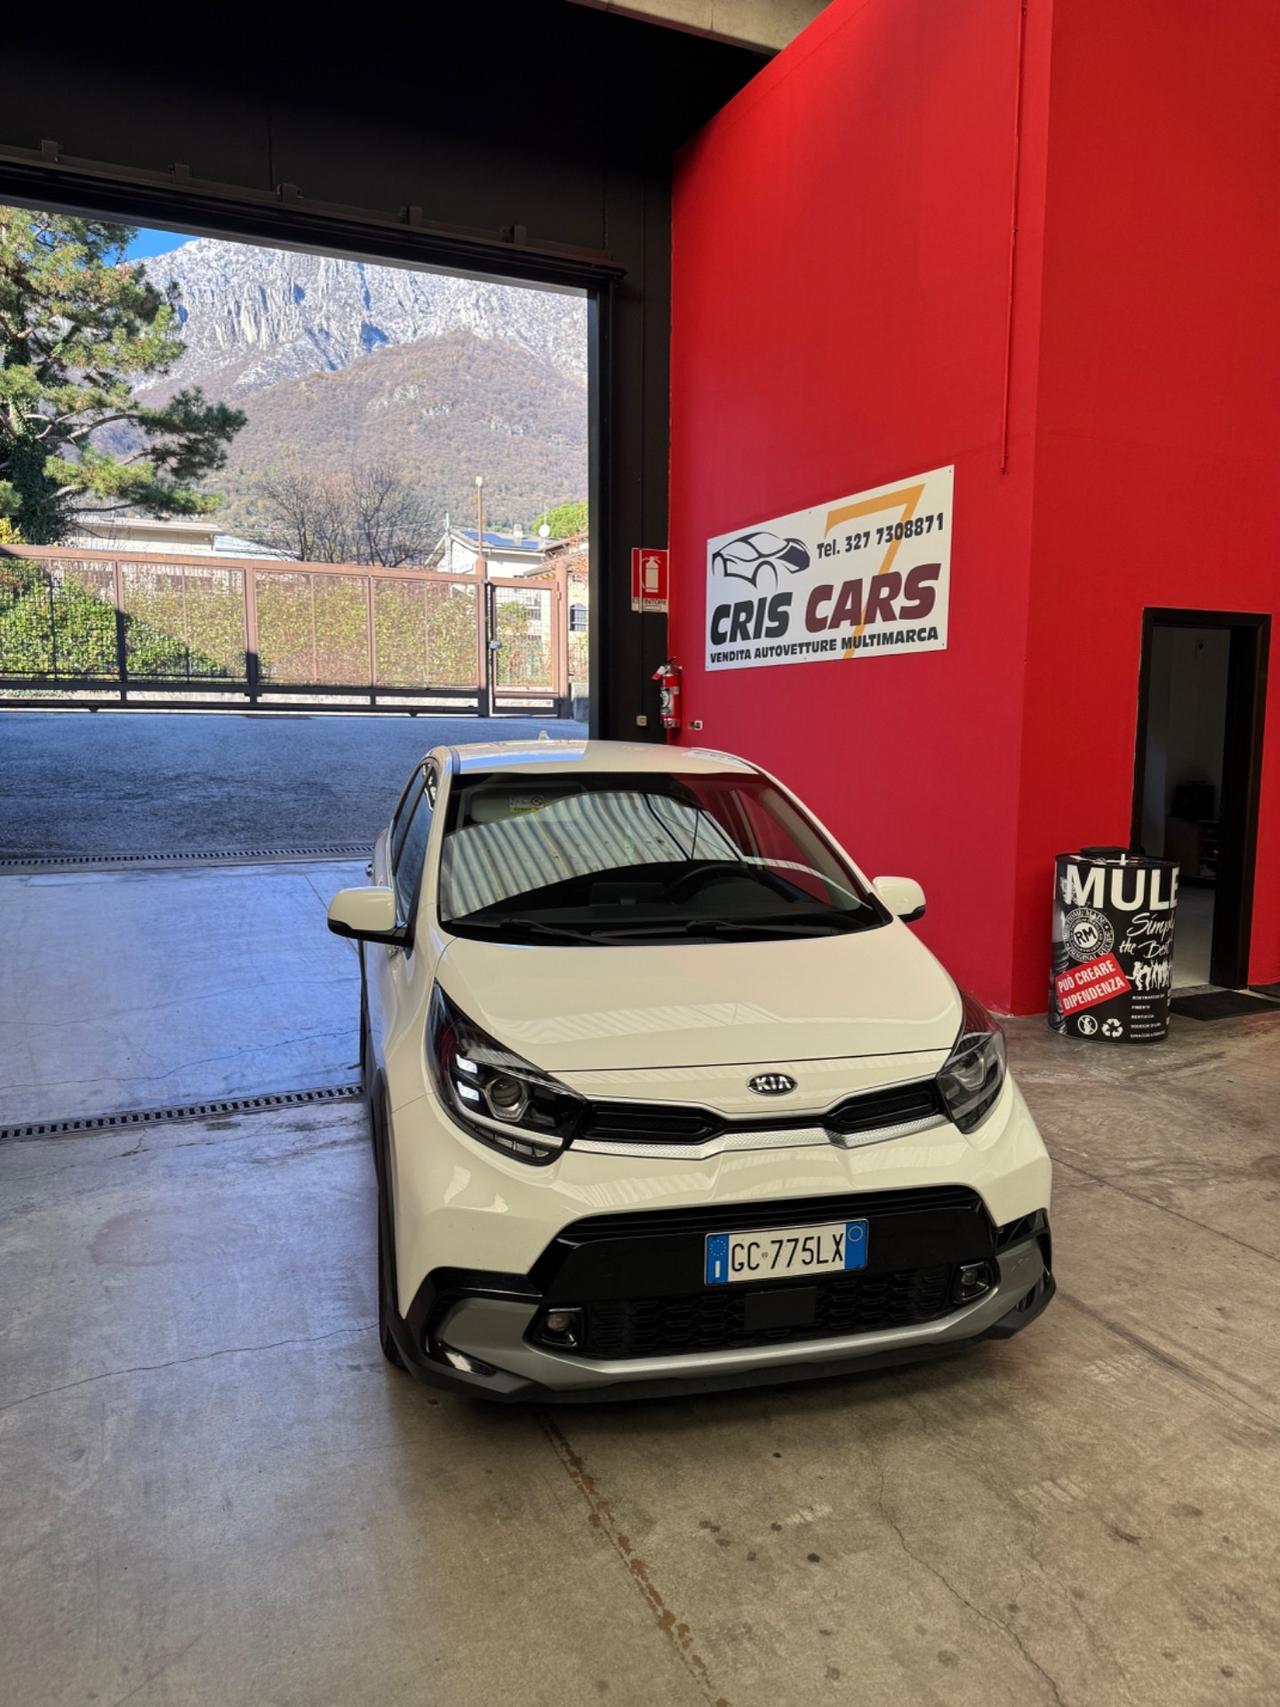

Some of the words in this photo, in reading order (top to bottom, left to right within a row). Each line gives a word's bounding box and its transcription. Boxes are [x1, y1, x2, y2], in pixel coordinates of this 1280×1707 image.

[816, 539, 840, 559] Tel.
[845, 531, 870, 552] 327
[876, 512, 943, 545] 7308871
[710, 592, 793, 645] CRIS
[805, 563, 942, 634] CARS
[710, 649, 751, 663] VENDITA
[754, 639, 837, 659] AUTOVETTURE
[841, 627, 938, 650] MULTIMARCA
[1074, 926, 1097, 945] RM
[1119, 937, 1136, 955] the
[1075, 960, 1116, 985] CREARE
[1063, 976, 1125, 1010] DIPENDENZA
[755, 1075, 792, 1091] KIA
